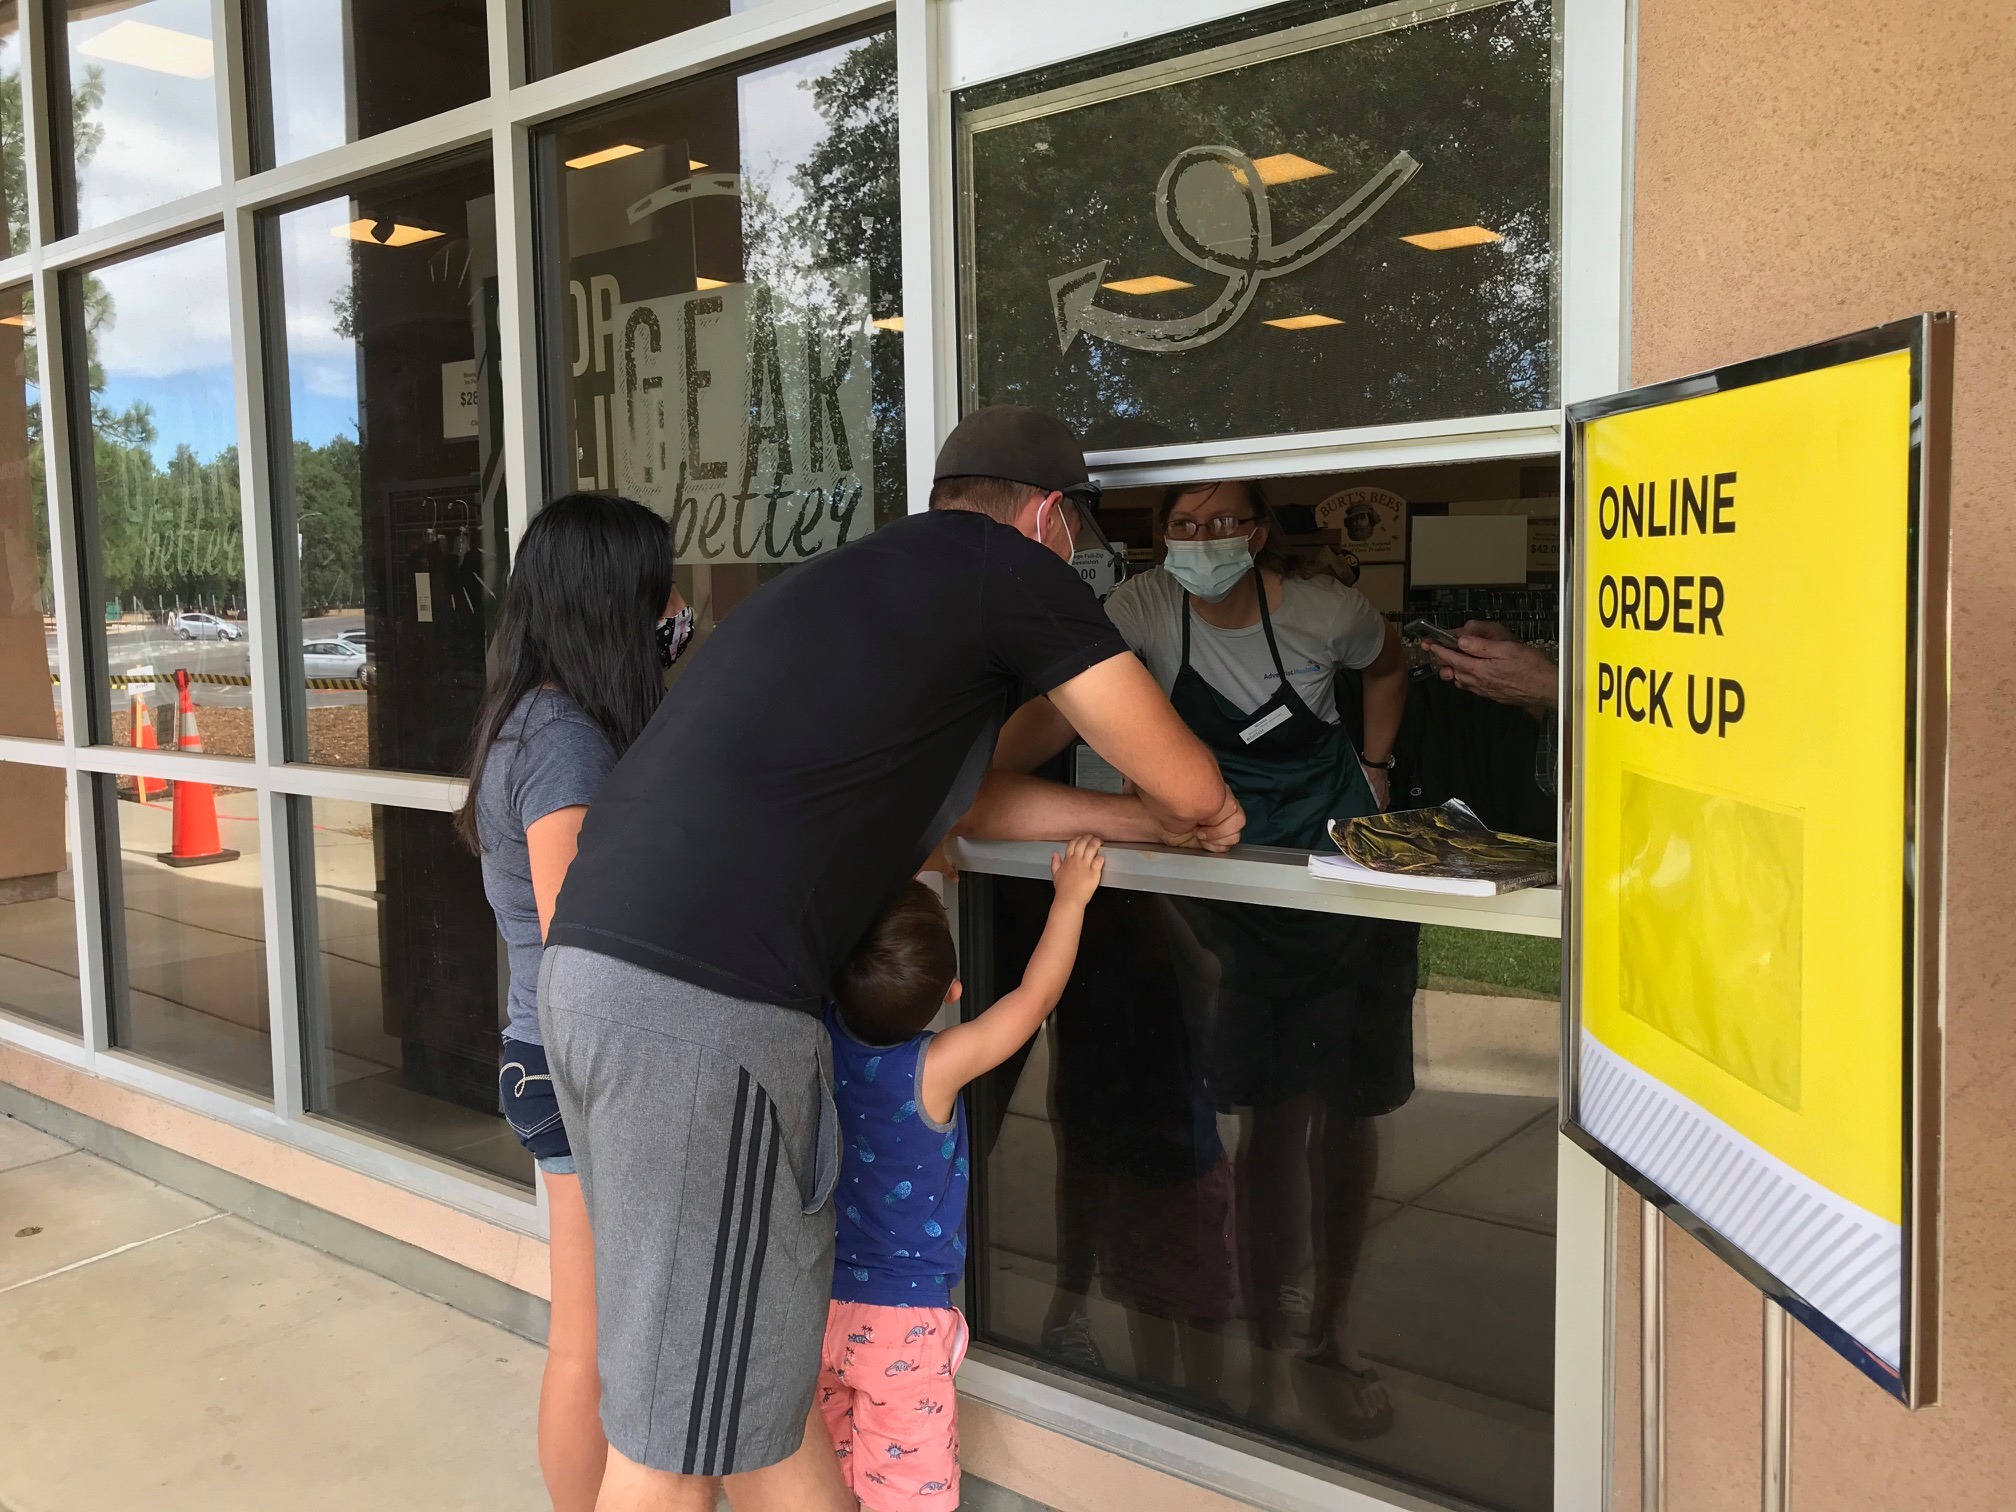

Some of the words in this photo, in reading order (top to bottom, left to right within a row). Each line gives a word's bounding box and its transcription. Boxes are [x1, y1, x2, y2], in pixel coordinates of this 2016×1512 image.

[625, 284, 853, 484] GEAR
[673, 461, 863, 559] better
[1319, 491, 1365, 518] BURT'S
[1370, 491, 1403, 512] BEES
[1599, 471, 1738, 540] ONLINE
[1598, 575, 1725, 636] ORDER
[1598, 662, 1674, 728] PICK
[1687, 674, 1746, 738] UP
